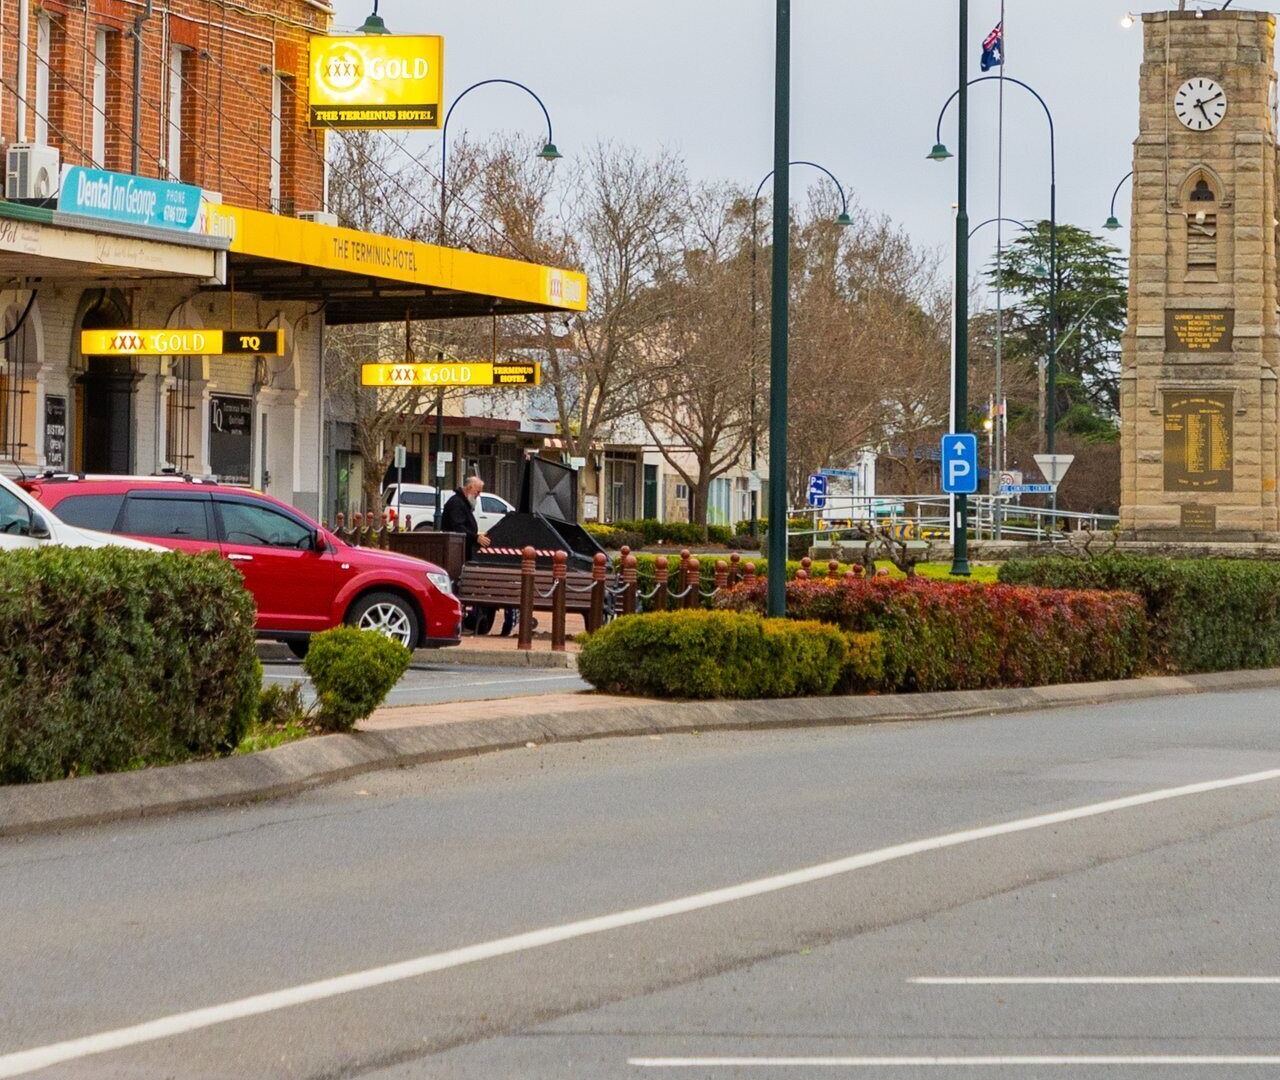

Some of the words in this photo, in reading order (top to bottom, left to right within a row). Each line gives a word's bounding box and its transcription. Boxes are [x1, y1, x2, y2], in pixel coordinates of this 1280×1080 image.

[323, 63, 360, 78] XXXX
[369, 56, 429, 80] GOLD
[315, 110, 339, 121] THE
[339, 110, 397, 121] TERMINUS
[397, 110, 434, 121] HOTEL
[76, 170, 113, 209] Dental
[113, 186, 126, 210] on
[126, 178, 157, 224] George
[166, 189, 186, 204] PHONE
[333, 238, 349, 260] THE
[351, 240, 391, 266] TERMINUS
[393, 250, 417, 271] HOTEL
[109, 334, 146, 350] XXXX
[154, 332, 205, 352] GOLD
[239, 336, 261, 350] TQ
[386, 369, 419, 381] XXXX
[425, 366, 471, 383] GOLD
[493, 366, 534, 375] TERMINUS
[500, 374, 527, 383] HOTEL
[949, 459, 971, 486] P
